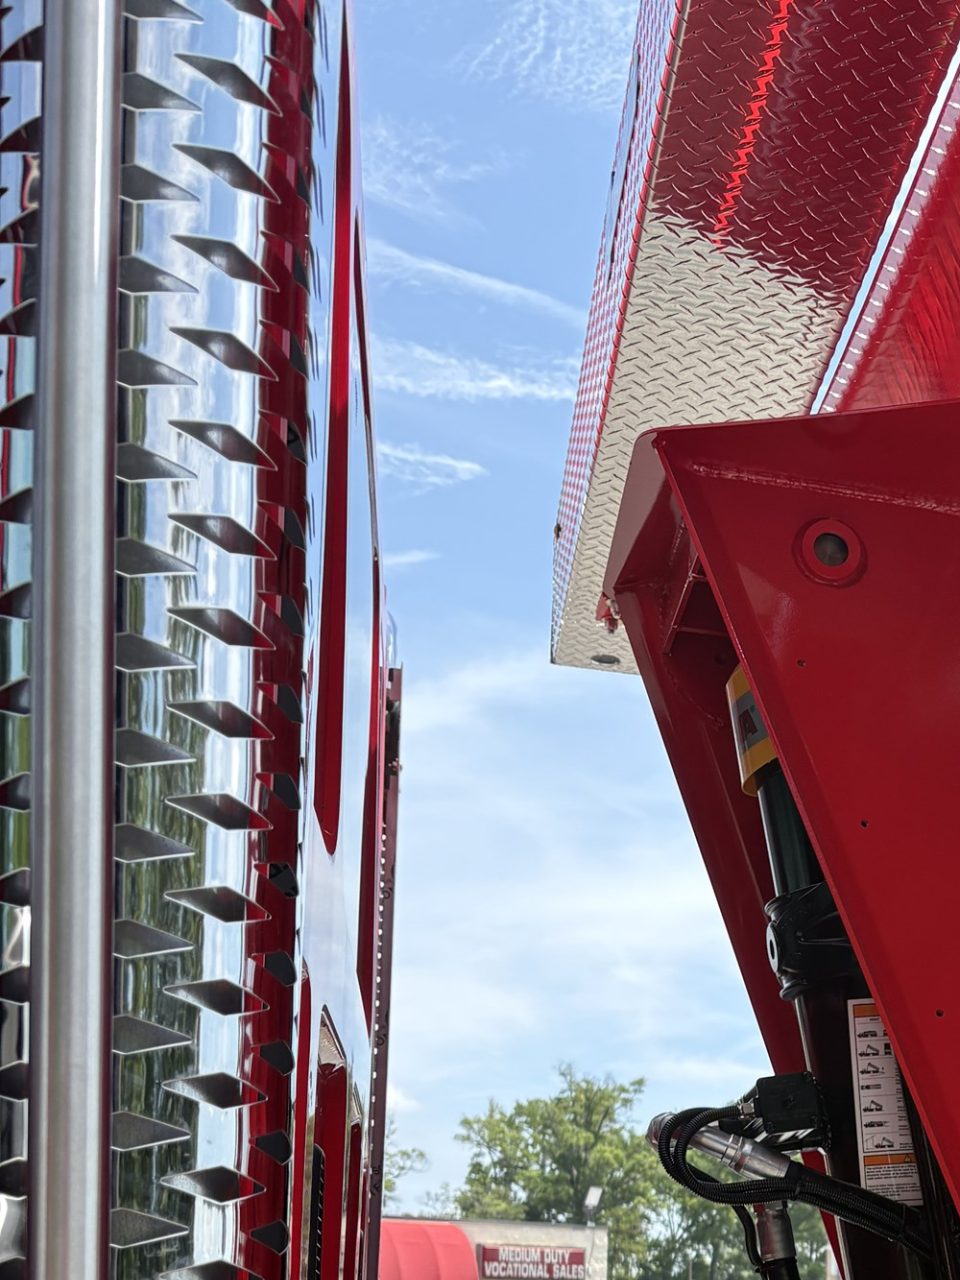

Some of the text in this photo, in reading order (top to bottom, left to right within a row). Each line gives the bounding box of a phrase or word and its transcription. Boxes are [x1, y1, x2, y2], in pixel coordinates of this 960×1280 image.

[499, 1246, 570, 1264] MEDIUM DUTY
[484, 1261, 585, 1279] VOCATIONAL SALES
